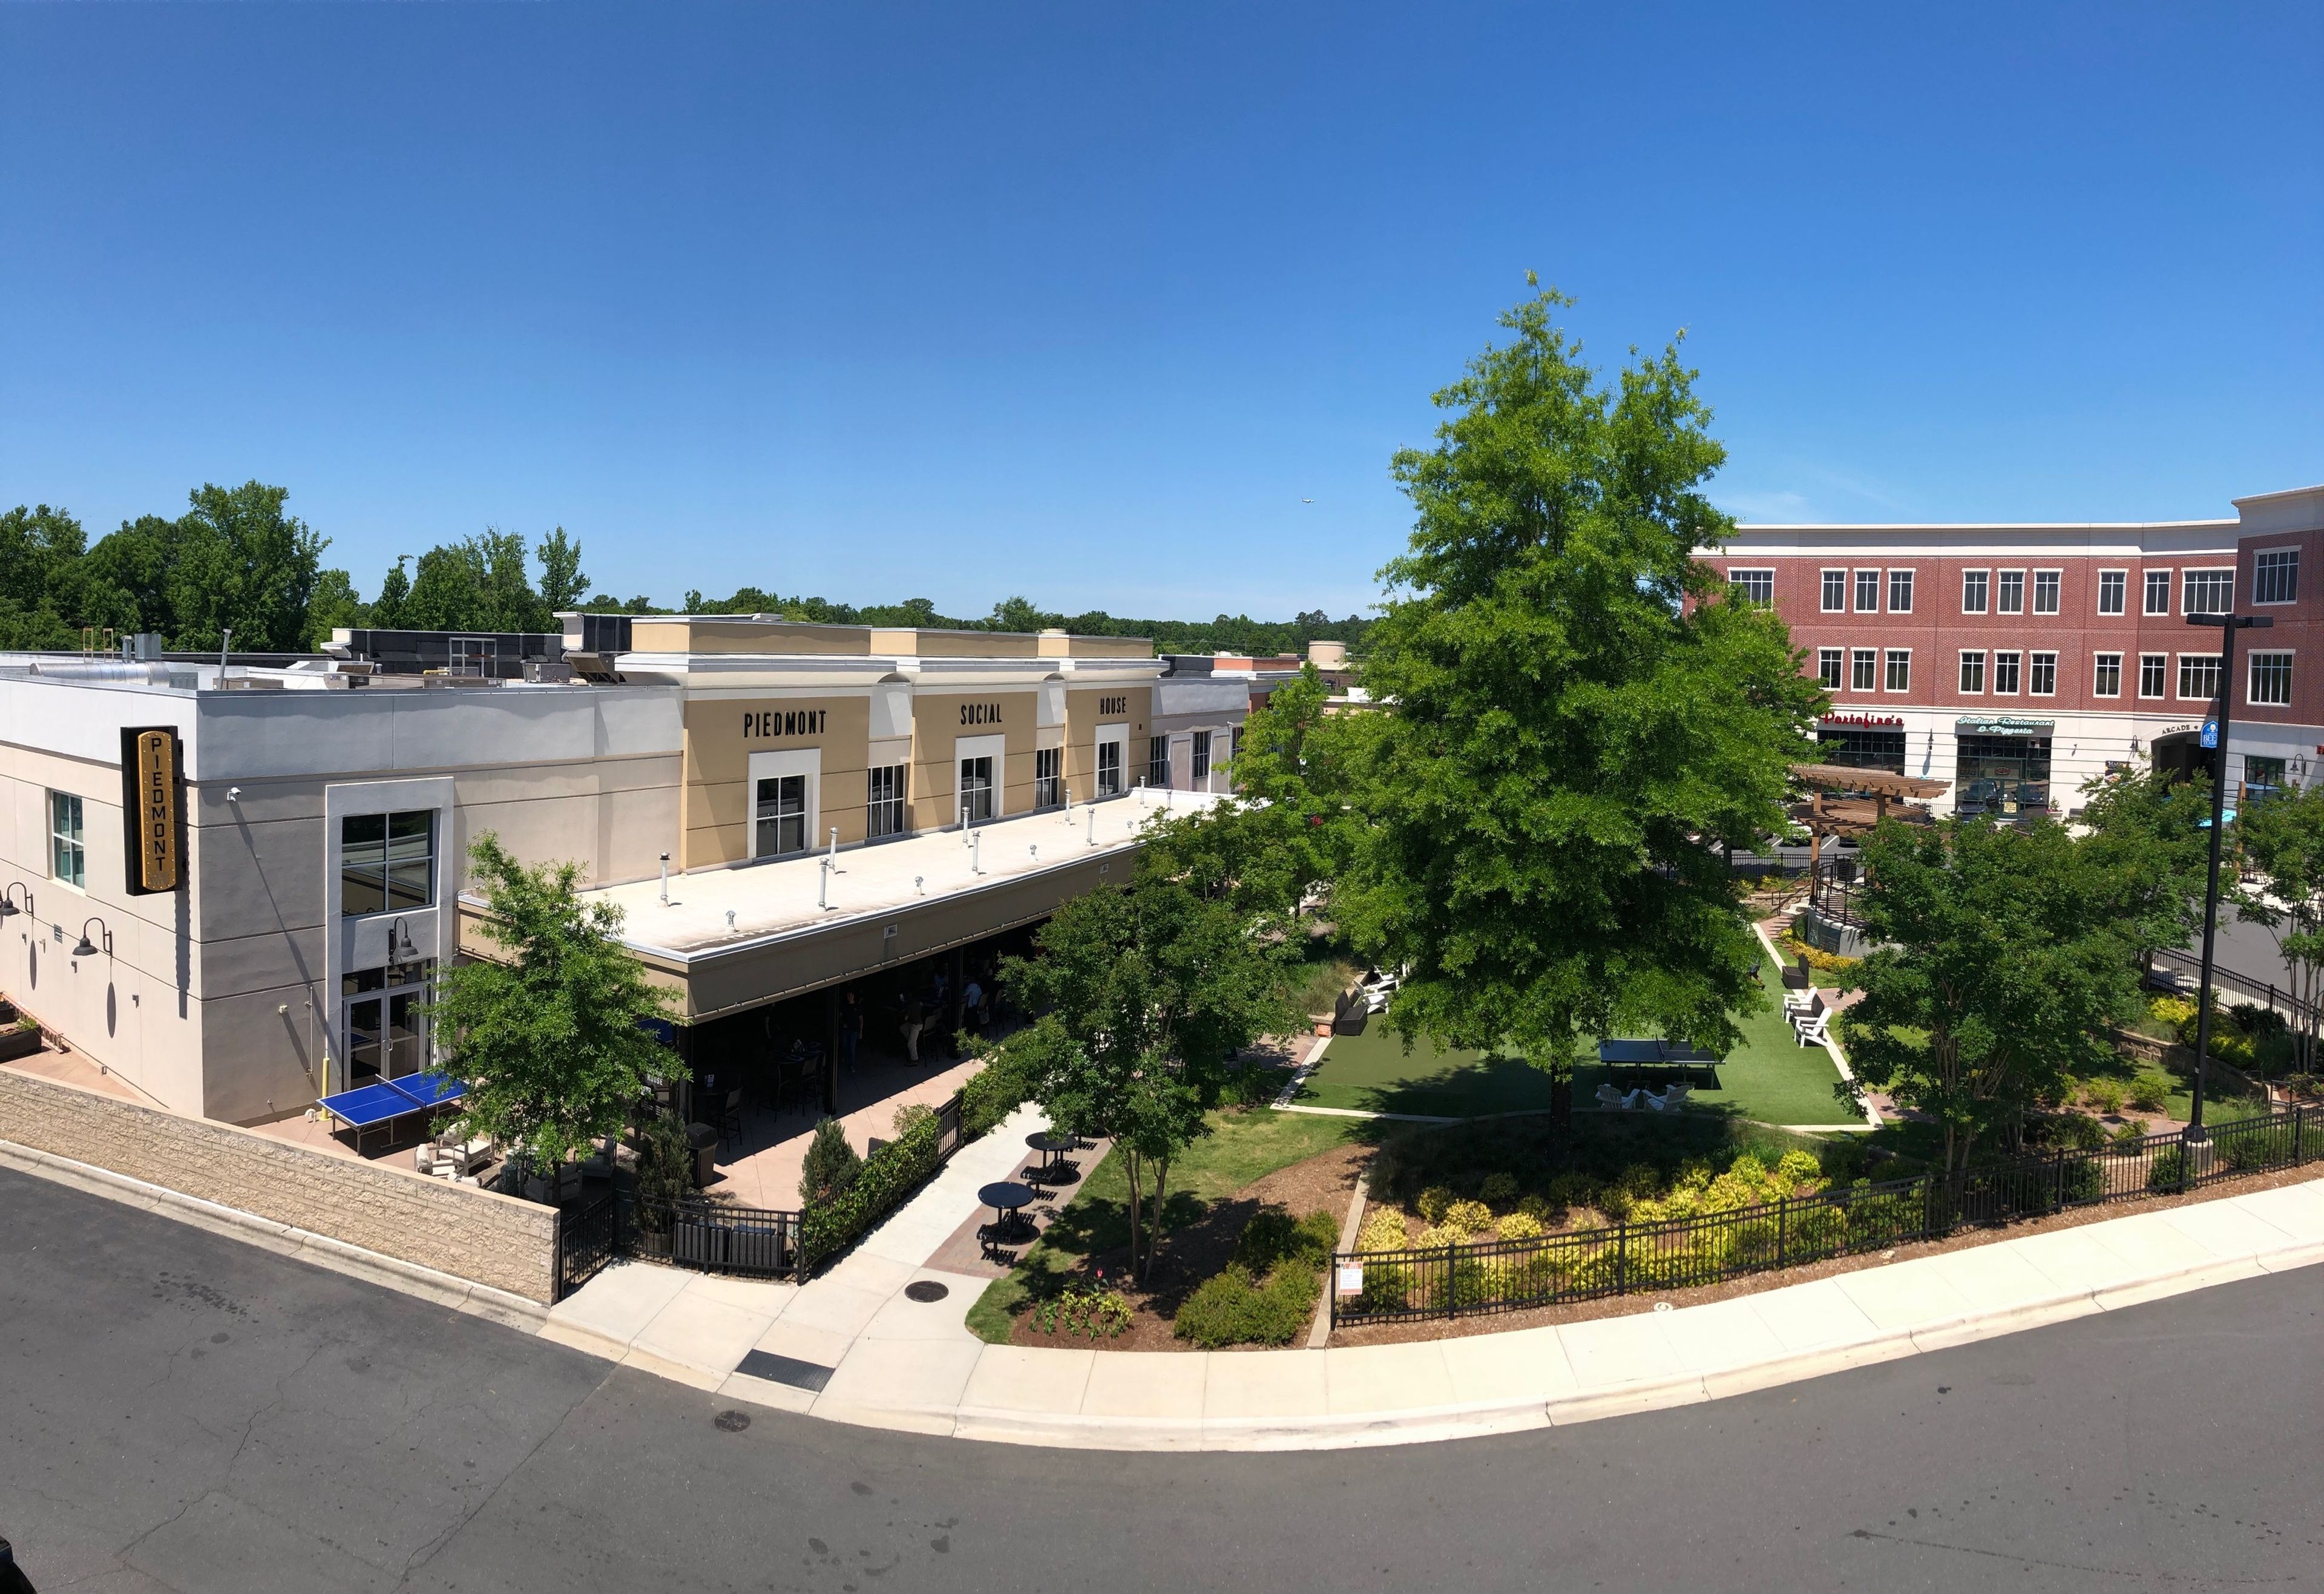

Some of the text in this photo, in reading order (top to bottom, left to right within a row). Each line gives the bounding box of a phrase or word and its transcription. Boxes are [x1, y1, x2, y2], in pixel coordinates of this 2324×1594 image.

[744, 697, 1126, 738] PIEDMONT SOCIAL HOUSE
[1819, 712, 1903, 728] Portofino's
[1957, 716, 2055, 726] Italian Restaurant
[1989, 726, 2034, 735] Pizzeria
[2162, 724, 2190, 735] ARCADE
[151, 738, 165, 871] PIEDMONT
[647, 1074, 663, 1086] HOUSE
